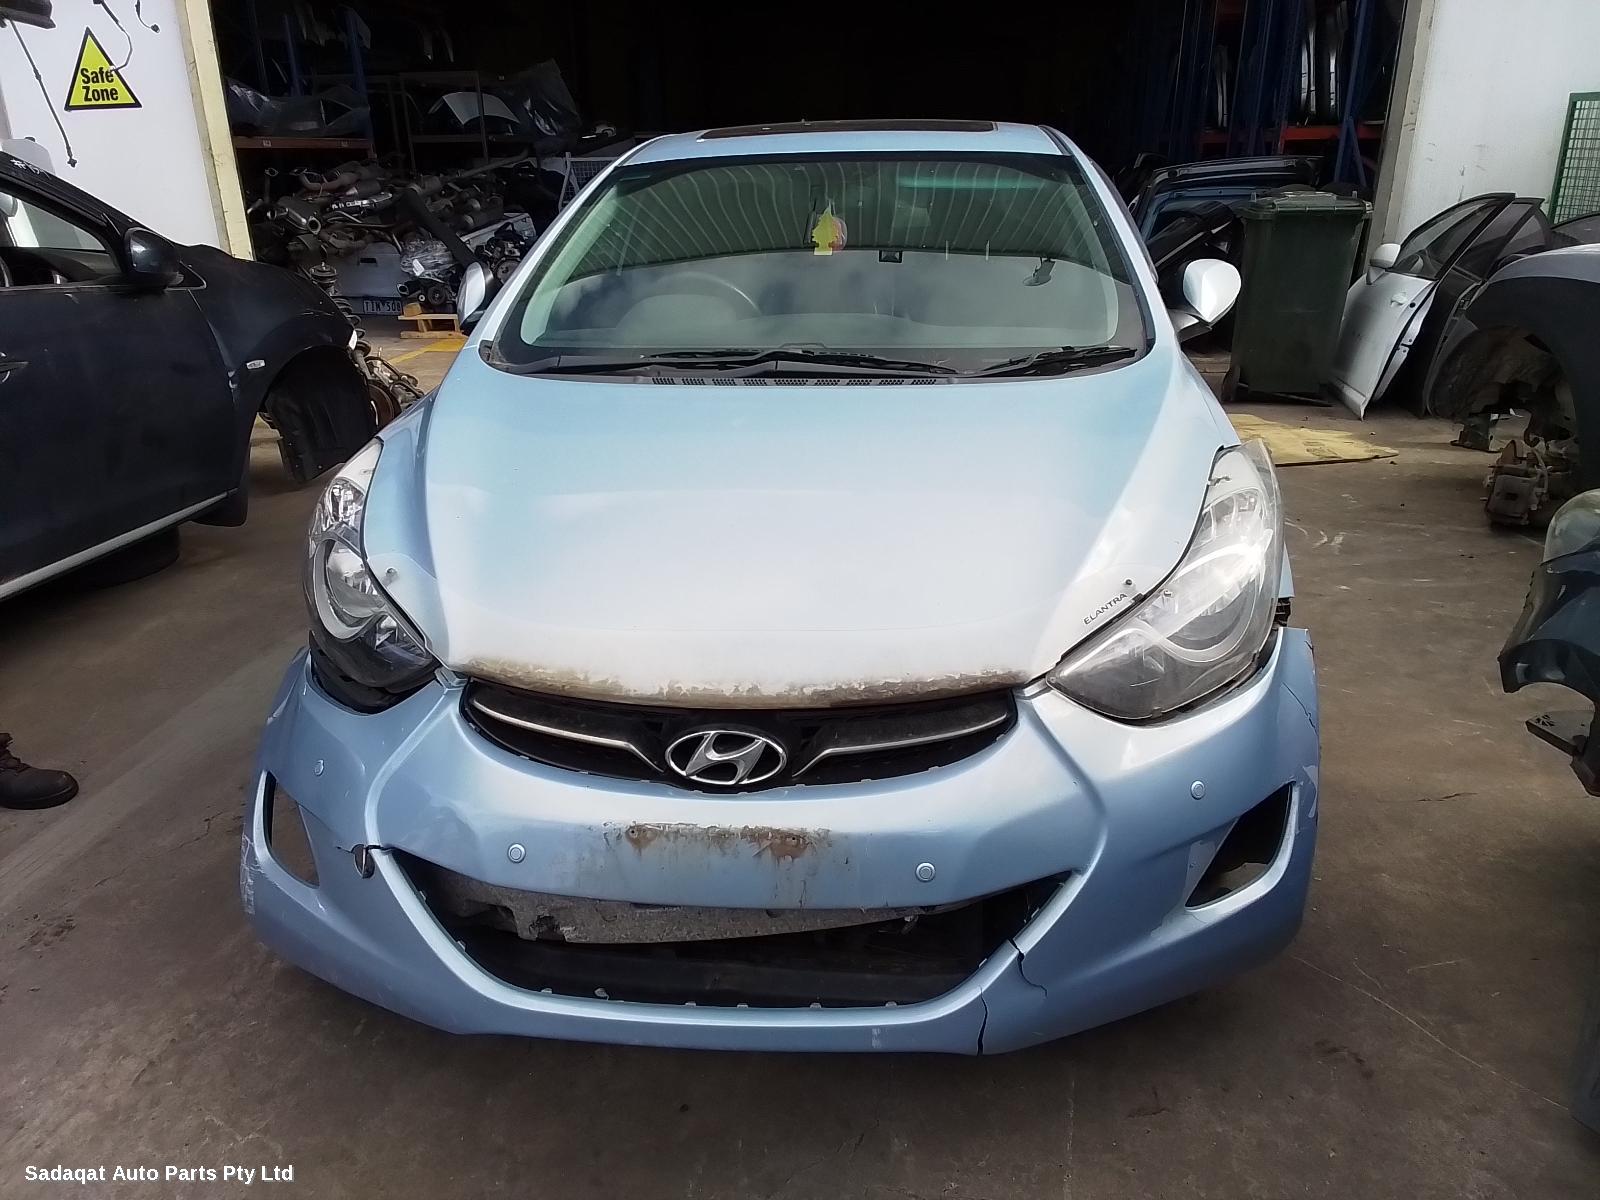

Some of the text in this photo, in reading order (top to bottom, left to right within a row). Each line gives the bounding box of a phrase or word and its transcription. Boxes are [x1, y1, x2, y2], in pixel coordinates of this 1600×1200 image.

[80, 66, 114, 84] Safe
[82, 86, 118, 102] Zone
[1083, 593, 1128, 625] ELANTRA
